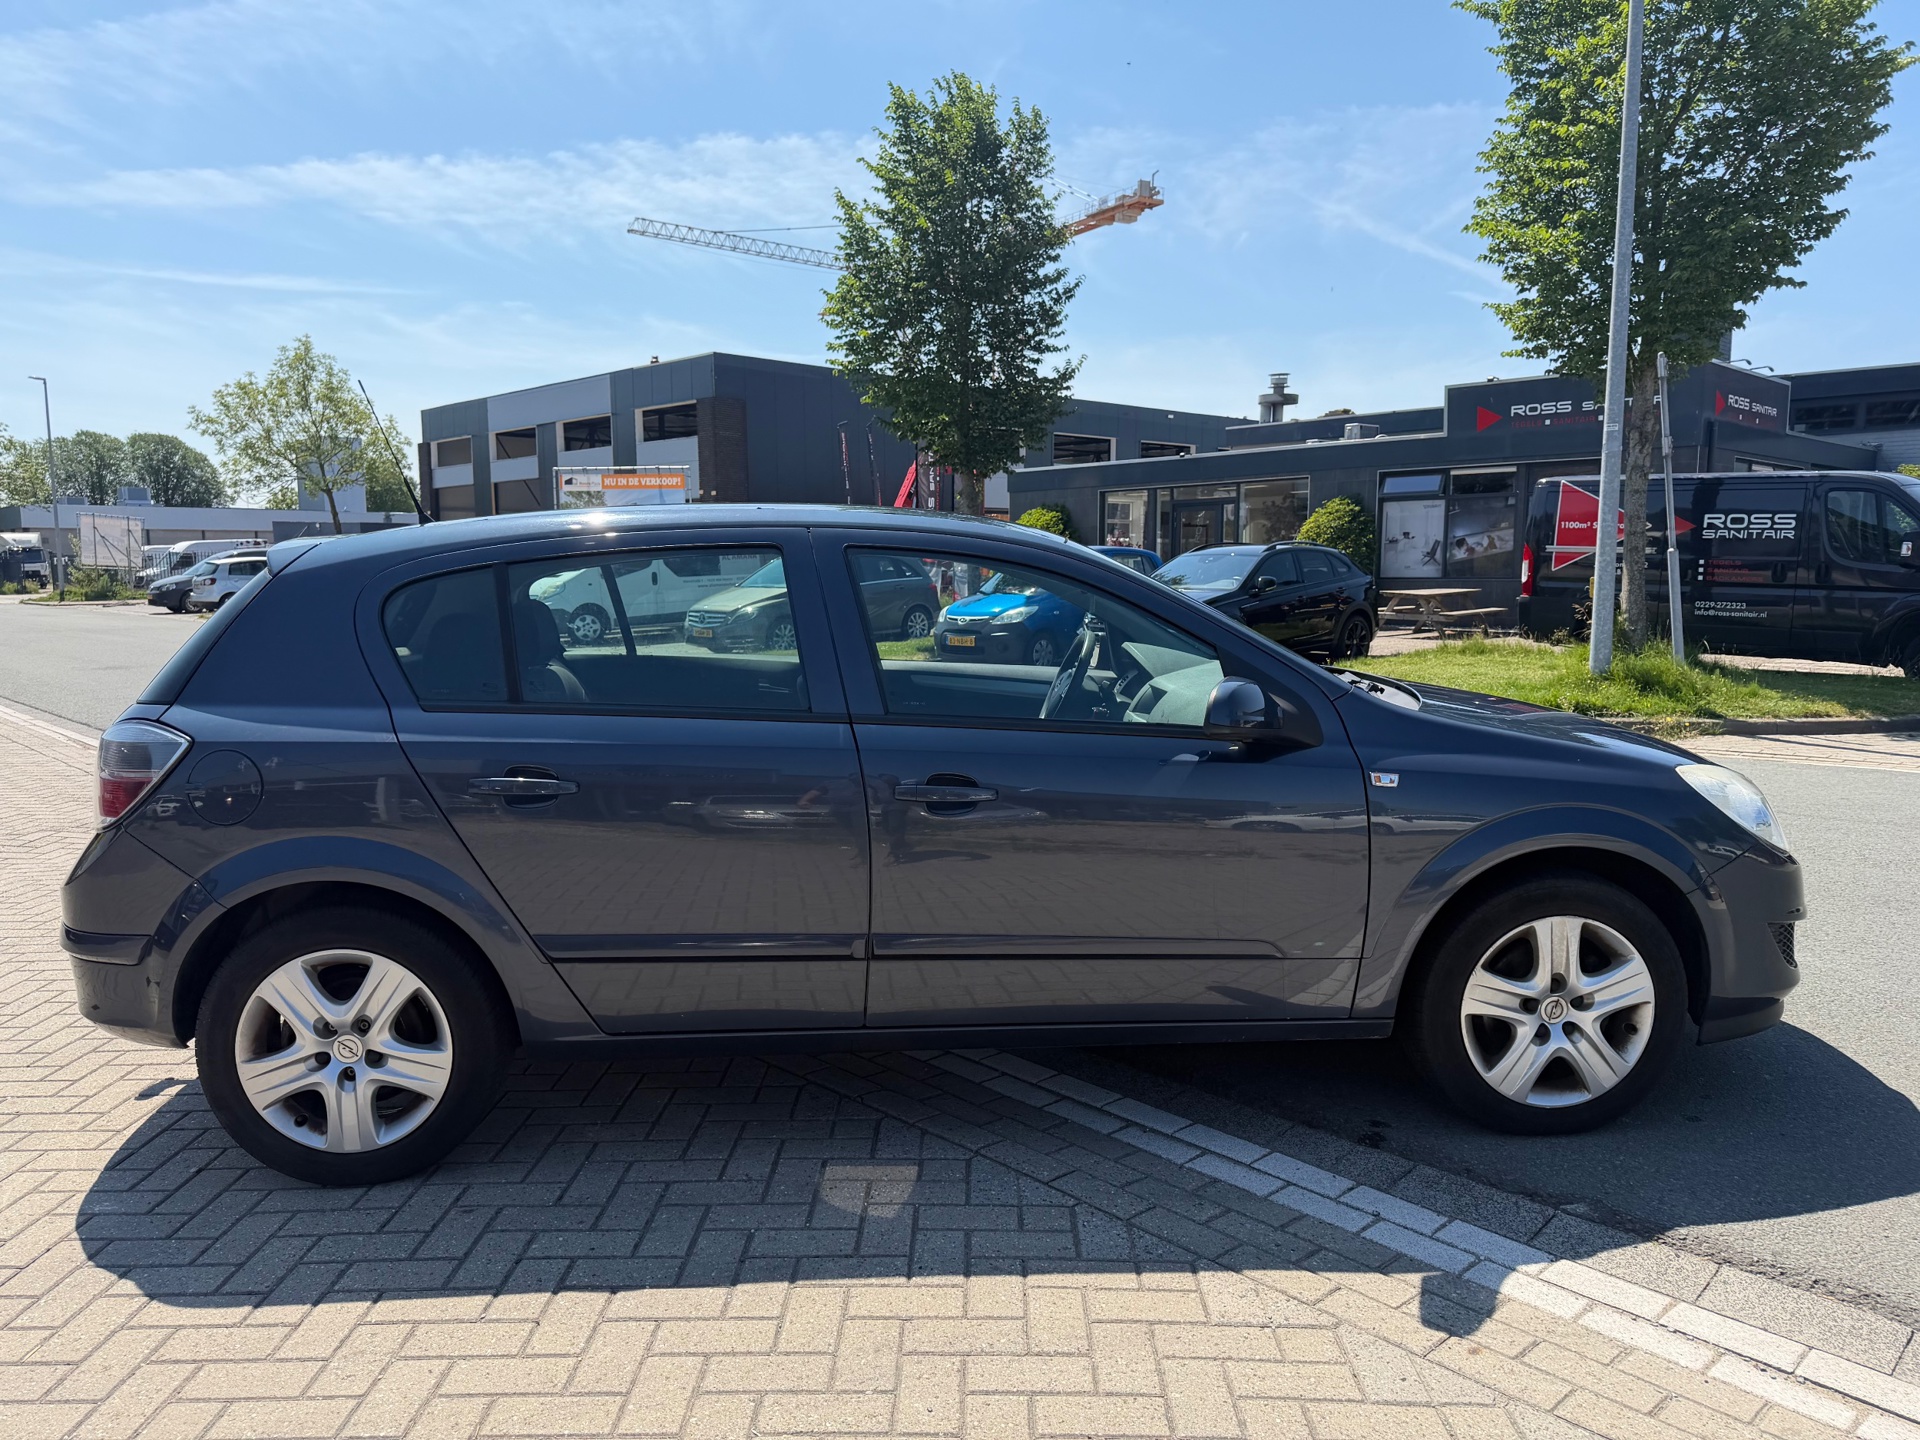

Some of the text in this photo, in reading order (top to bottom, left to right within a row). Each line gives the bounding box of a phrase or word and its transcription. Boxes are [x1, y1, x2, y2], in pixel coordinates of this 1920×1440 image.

[1510, 400, 1572, 417] ROSS
[1728, 394, 1778, 417] ROSS SANITAIR
[1553, 415, 1596, 425] SANITAIR
[604, 477, 617, 486] NU
[617, 477, 627, 486] IN
[628, 477, 639, 486] DE
[640, 477, 681, 486] VERKOOP!
[1703, 513, 1797, 529] ROSS
[1701, 529, 1796, 540] SANITAIR
[1694, 601, 1747, 609] 0229-272323
[1694, 609, 1768, 618] info@ross-sanitair.nl
